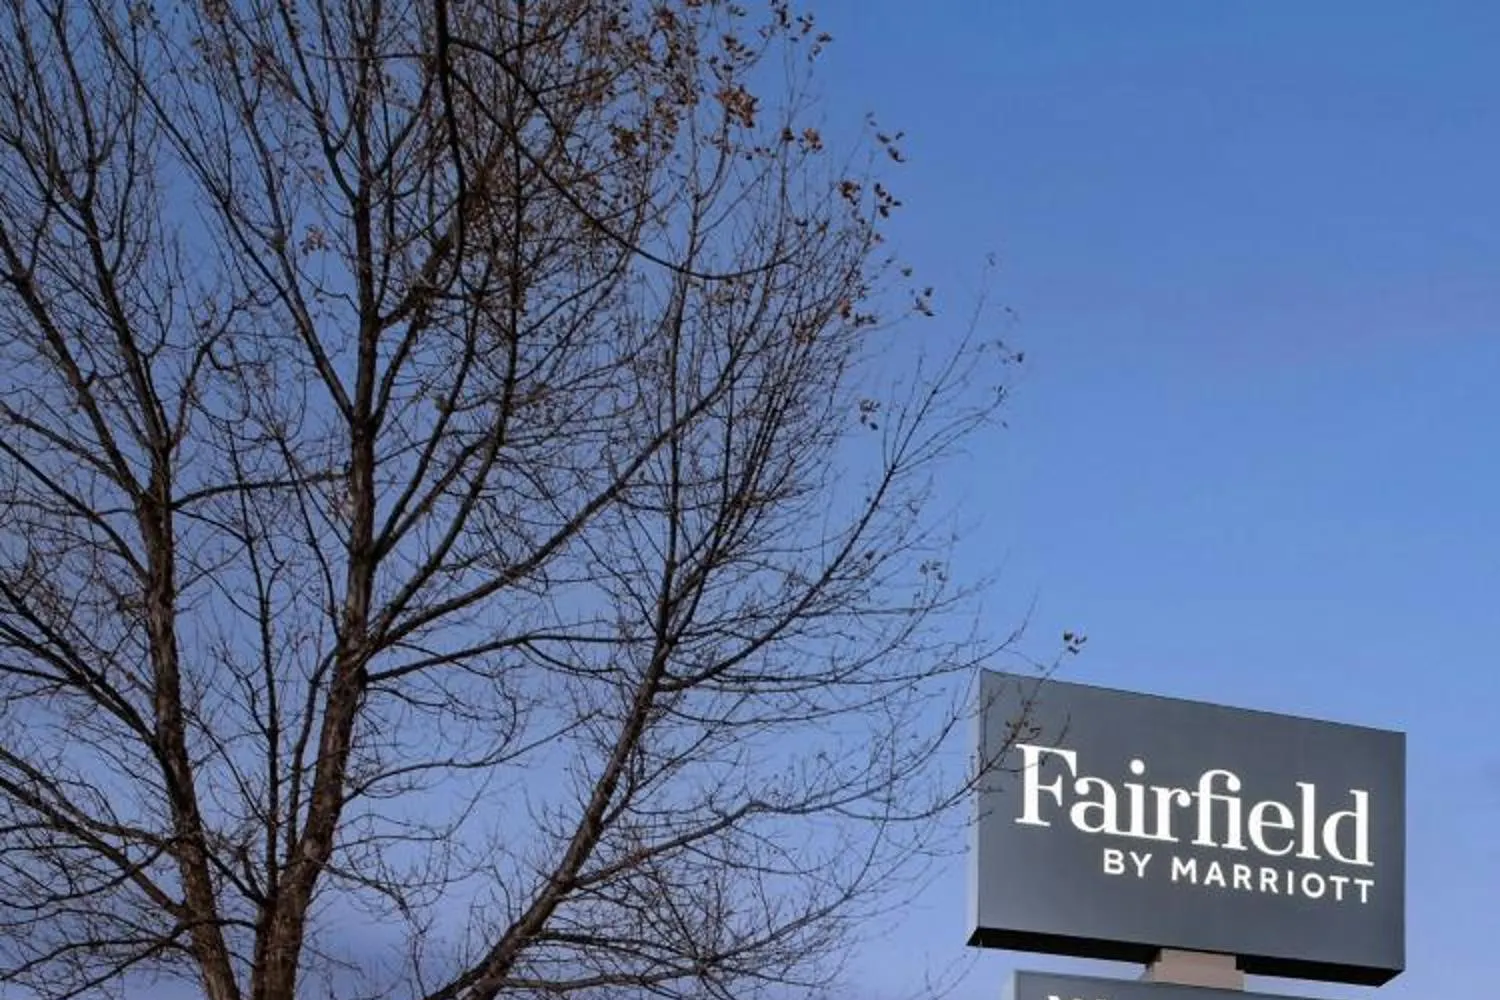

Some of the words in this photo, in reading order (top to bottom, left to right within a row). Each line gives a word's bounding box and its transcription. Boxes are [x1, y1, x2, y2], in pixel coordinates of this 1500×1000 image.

[1014, 743, 1375, 867] Fairfield
[1103, 849, 1153, 878] BY
[1171, 857, 1375, 904] MARRIOTT
